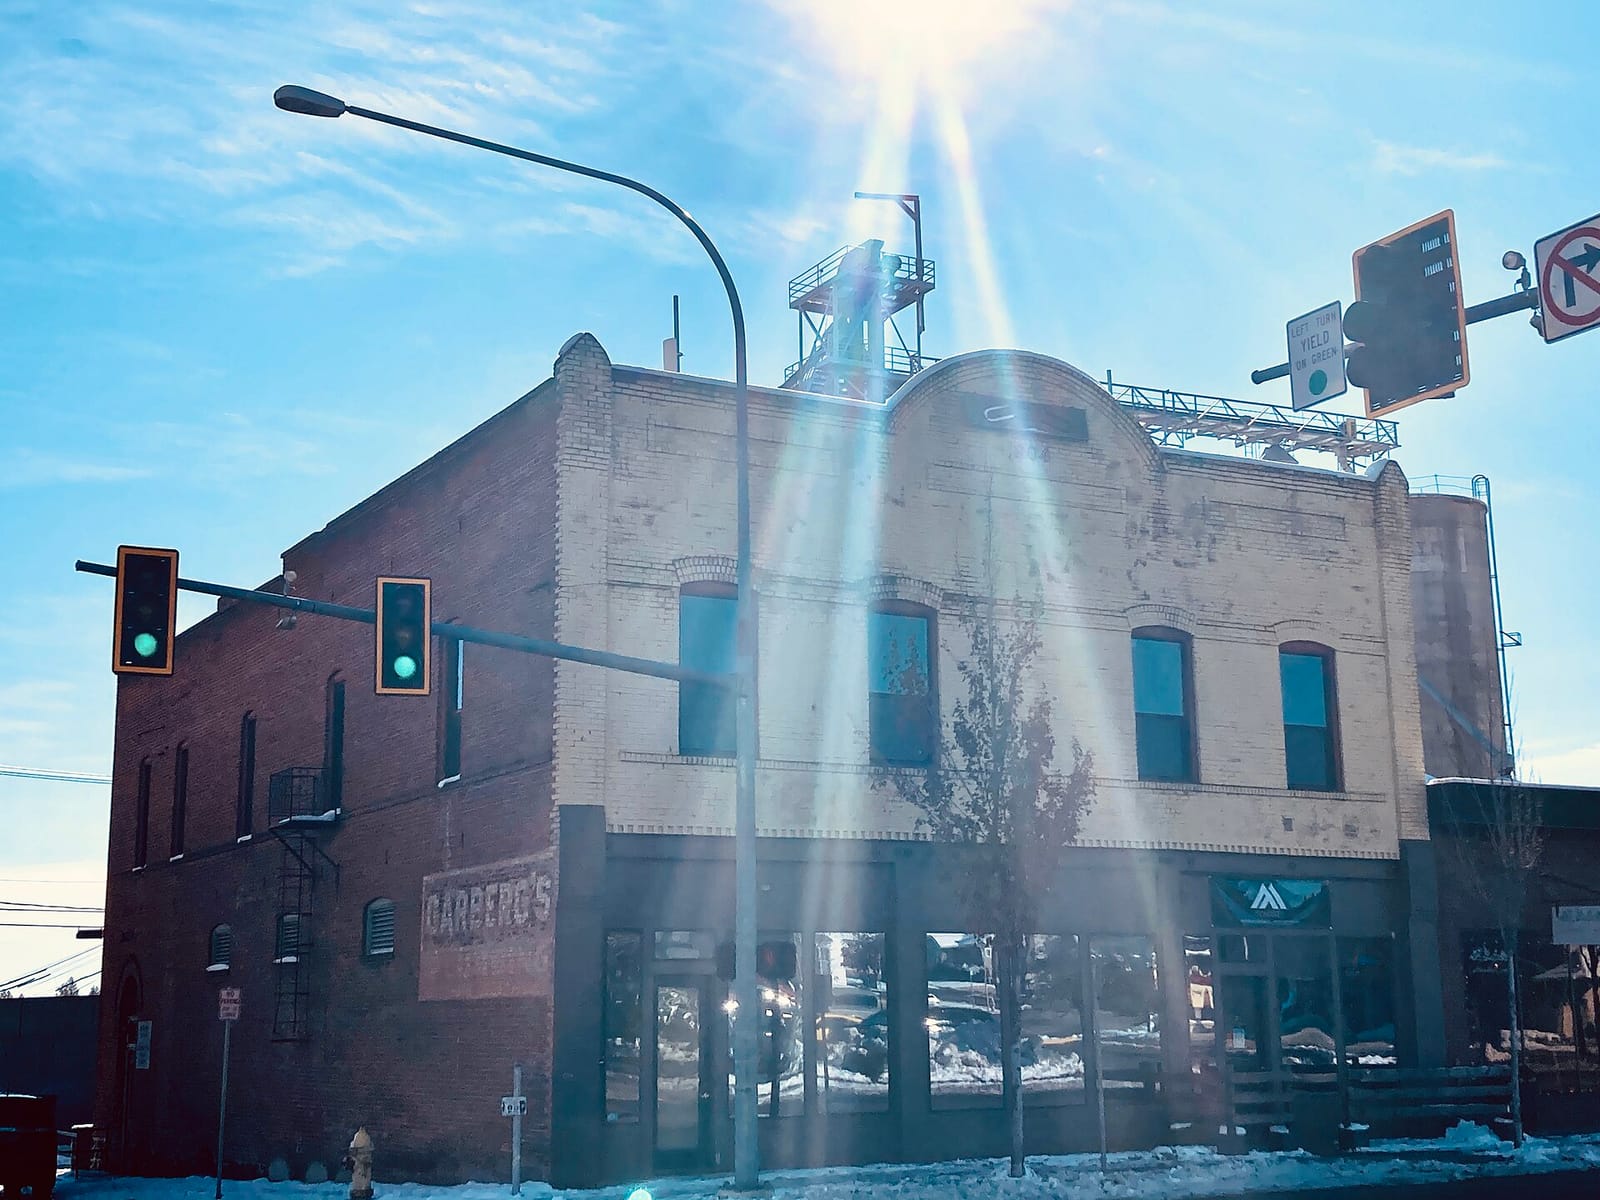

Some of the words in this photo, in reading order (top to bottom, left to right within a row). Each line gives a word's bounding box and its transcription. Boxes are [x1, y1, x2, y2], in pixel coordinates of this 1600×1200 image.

[1291, 322, 1309, 338] LEFT
[1316, 311, 1337, 326] TURN
[1300, 330, 1330, 353] YIELD
[1296, 358, 1307, 371] ON
[1311, 346, 1337, 365] GREEN
